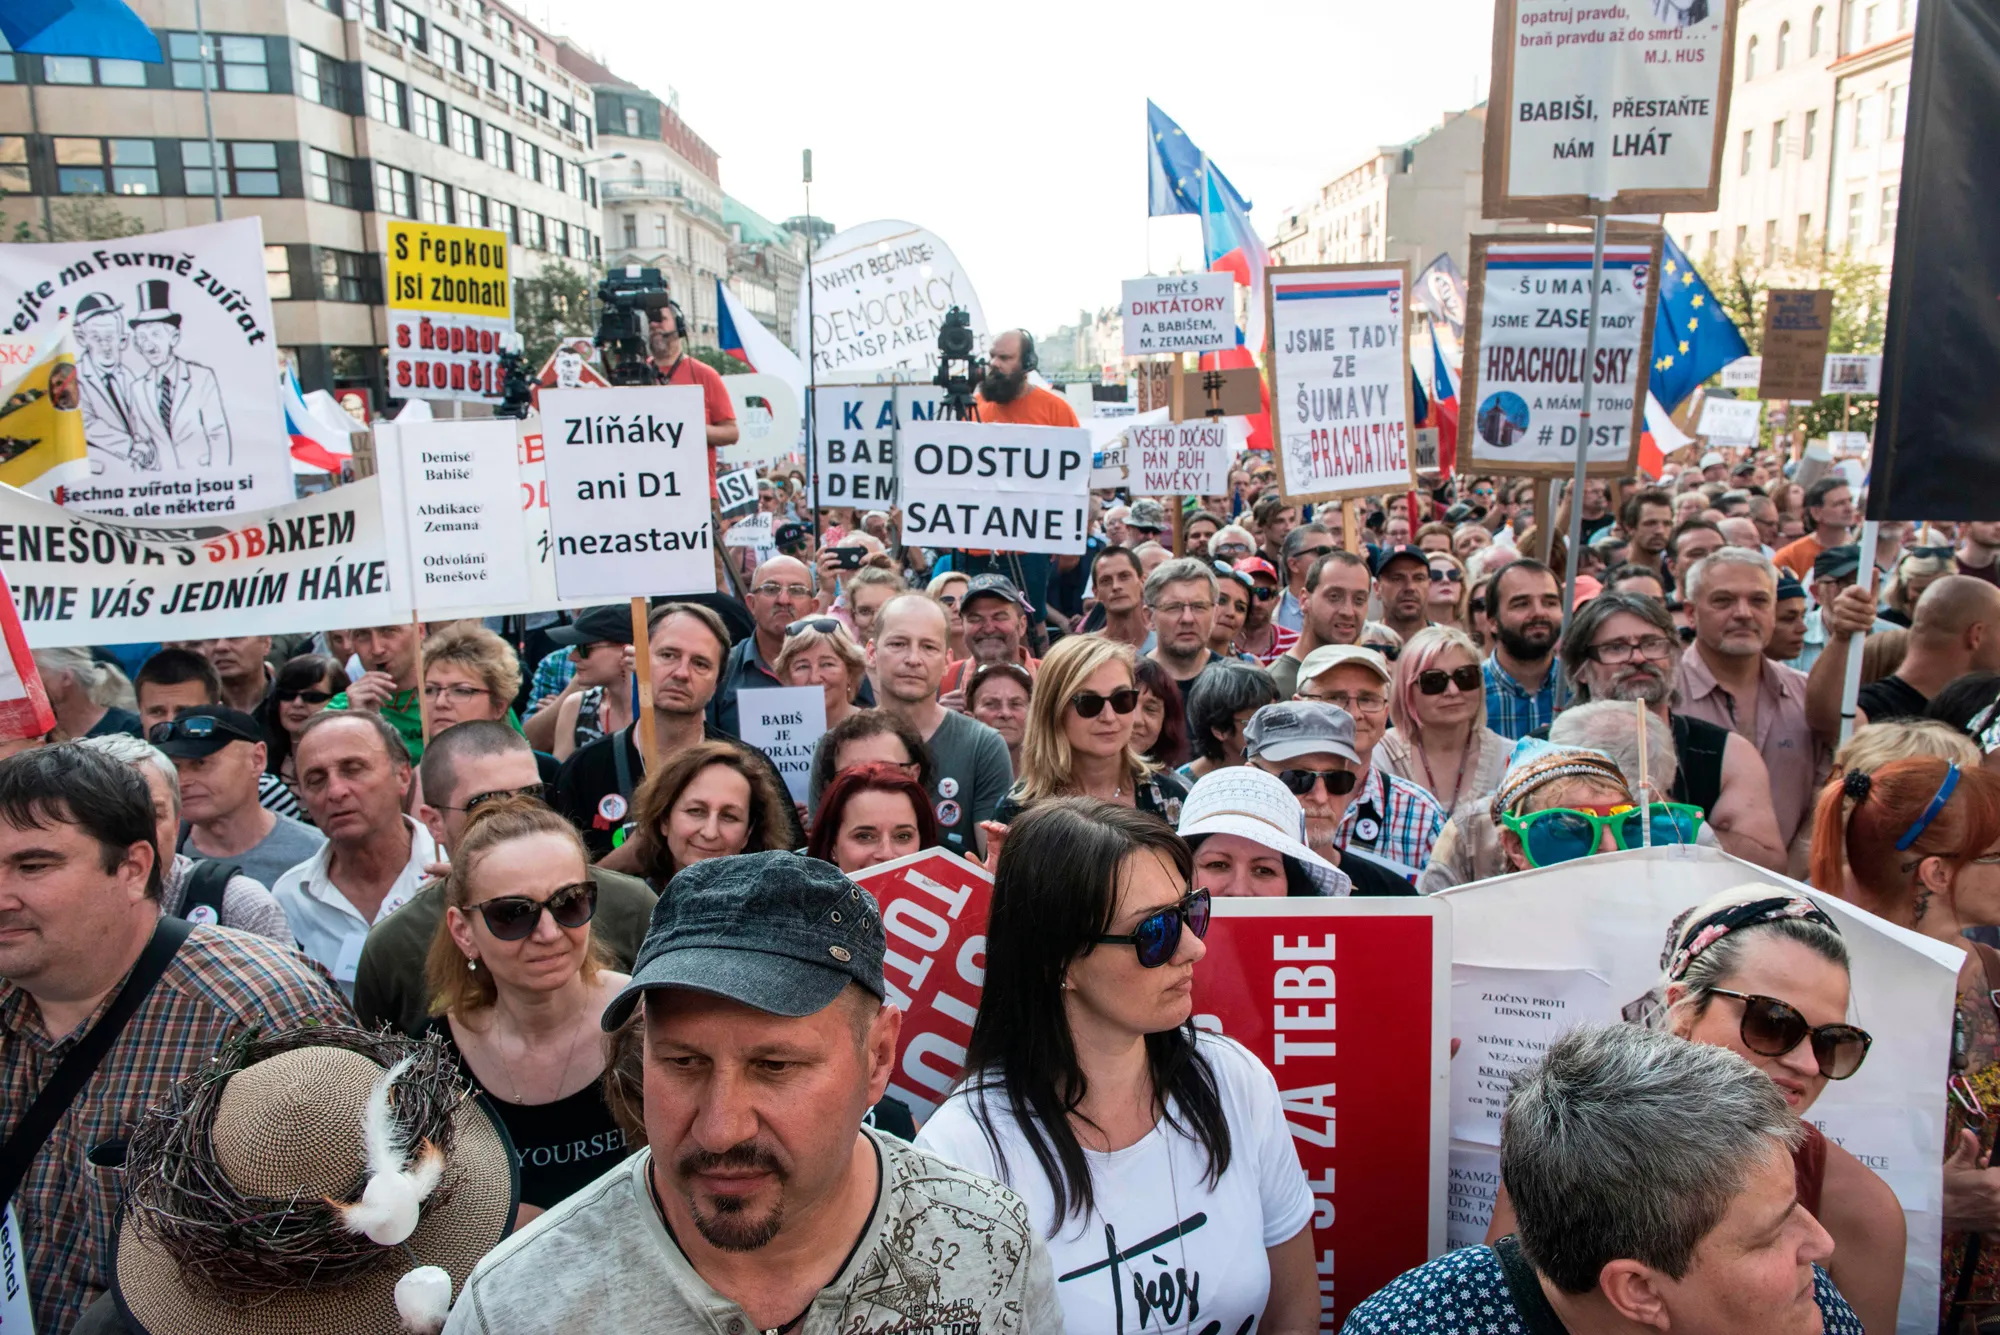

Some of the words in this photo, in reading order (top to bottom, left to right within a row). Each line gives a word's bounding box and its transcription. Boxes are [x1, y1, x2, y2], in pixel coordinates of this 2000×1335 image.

[1522, 8, 1573, 26] opatruj
[1576, 5, 1630, 24] pravdu,
[1520, 33, 1553, 47] braň
[1556, 30, 1605, 48] pravdu
[1609, 28, 1625, 43] až
[1628, 27, 1645, 41] do
[1675, 48, 1705, 63] HUS
[1519, 94, 1599, 123] BABIŠI,
[1612, 95, 1710, 119] PŘESTAŇTE
[1553, 137, 1594, 160] NÁM
[1612, 127, 1672, 157] LHÁT
[420, 231, 503, 269] řepkou
[815, 263, 864, 292] WHY?
[1157, 279, 1188, 294] PRYČ
[1191, 281, 1198, 293] S
[59, 261, 95, 286] na
[93, 251, 196, 277] Farmě
[193, 269, 267, 346] zvířat
[396, 271, 422, 301] jsi
[431, 275, 506, 307] zbohatl
[813, 271, 956, 346] DEMOCRACY
[1132, 295, 1225, 316] DIKTÁTORY
[1142, 322, 1154, 333] A.
[1158, 318, 1216, 333] BABIŠEM,
[1491, 315, 1530, 328] JSME
[1535, 308, 1591, 328] ZASE
[1601, 315, 1636, 329] TADY
[1140, 338, 1155, 348] M.
[1159, 334, 1223, 348] ZEMANEM
[1285, 328, 1335, 354] JSME
[1349, 325, 1398, 349] TADY
[1333, 355, 1356, 378] ZE
[1298, 382, 1389, 423] ŠUMAVY
[1533, 398, 1543, 409] A
[1598, 397, 1633, 410] TOHO
[564, 414, 684, 448] Zlíňáky
[1133, 427, 1175, 448] VŠEHO
[1180, 426, 1224, 448] DOČASU
[1311, 421, 1407, 479] PRACHATICE
[914, 443, 1081, 481] ODSTUP
[129, 482, 191, 498] zvířata
[196, 479, 233, 496] jsou
[238, 475, 253, 490] si
[577, 472, 626, 500] ani
[638, 471, 681, 498] D1
[133, 502, 162, 517] ale
[165, 499, 235, 515] některá
[558, 522, 709, 556] nezastaví
[423, 553, 486, 567] Odvolání
[91, 579, 154, 618] VÁS
[160, 568, 289, 615] JEDNÍM
[298, 556, 391, 601] HÁKE
[425, 570, 488, 584] Benešové
[761, 711, 803, 726] BABIŠ
[775, 730, 790, 741] JE
[1272, 932, 1337, 1066] TEBE
[1482, 993, 1528, 1005] ZLOČINY
[1533, 998, 1565, 1008] PROTI
[1495, 1007, 1552, 1020] LIDSKOSTI
[1478, 1035, 1514, 1047] SUĎME
[1478, 1081, 1484, 1089] V
[1486, 1098, 1500, 1106] 700
[1283, 1082, 1337, 1148] ZA
